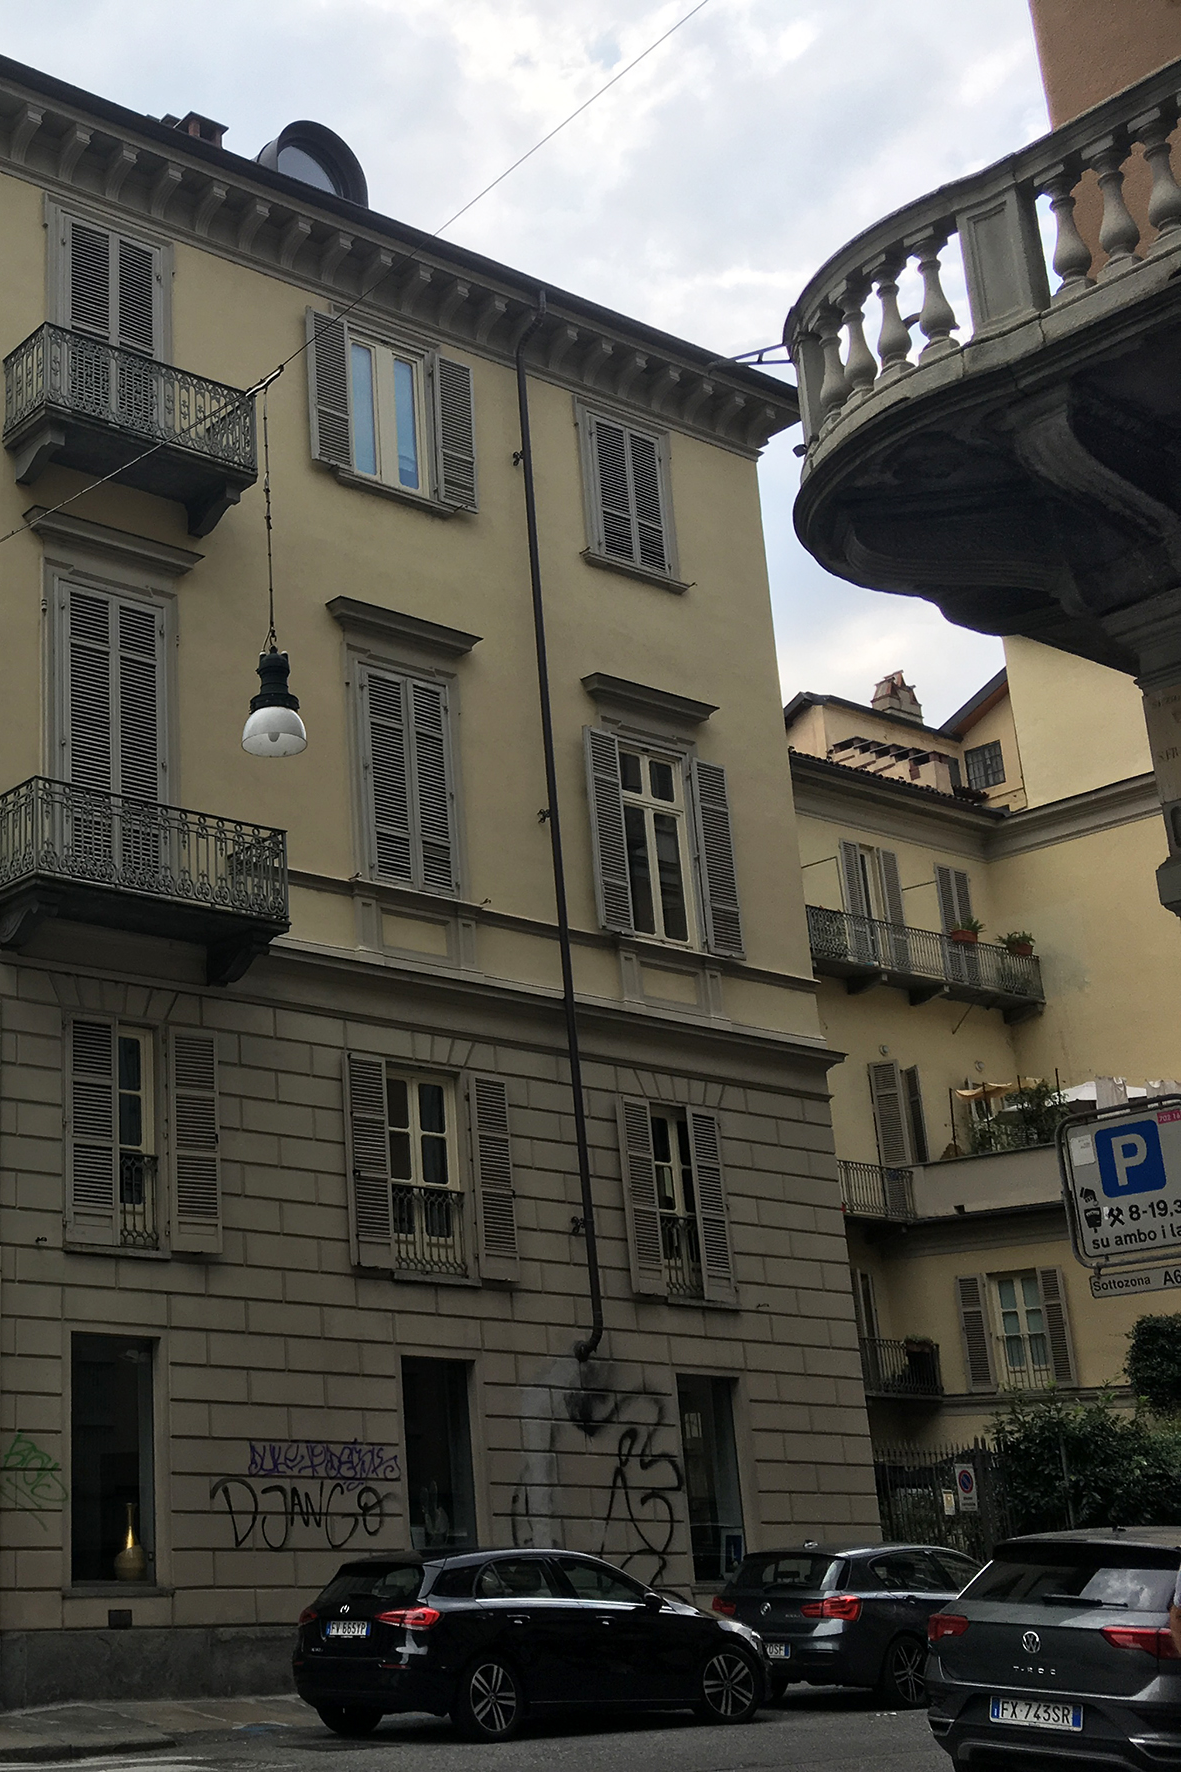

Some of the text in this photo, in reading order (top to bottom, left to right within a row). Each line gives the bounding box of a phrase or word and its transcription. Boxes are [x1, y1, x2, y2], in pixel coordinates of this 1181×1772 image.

[1110, 1133, 1148, 1187] P
[1092, 1237, 1110, 1249] su
[1114, 1228, 1157, 1246] ambo
[1161, 1225, 1166, 1239] i
[1093, 1276, 1151, 1292] Sottozona
[1001, 1701, 1071, 1724] FX 743SR
